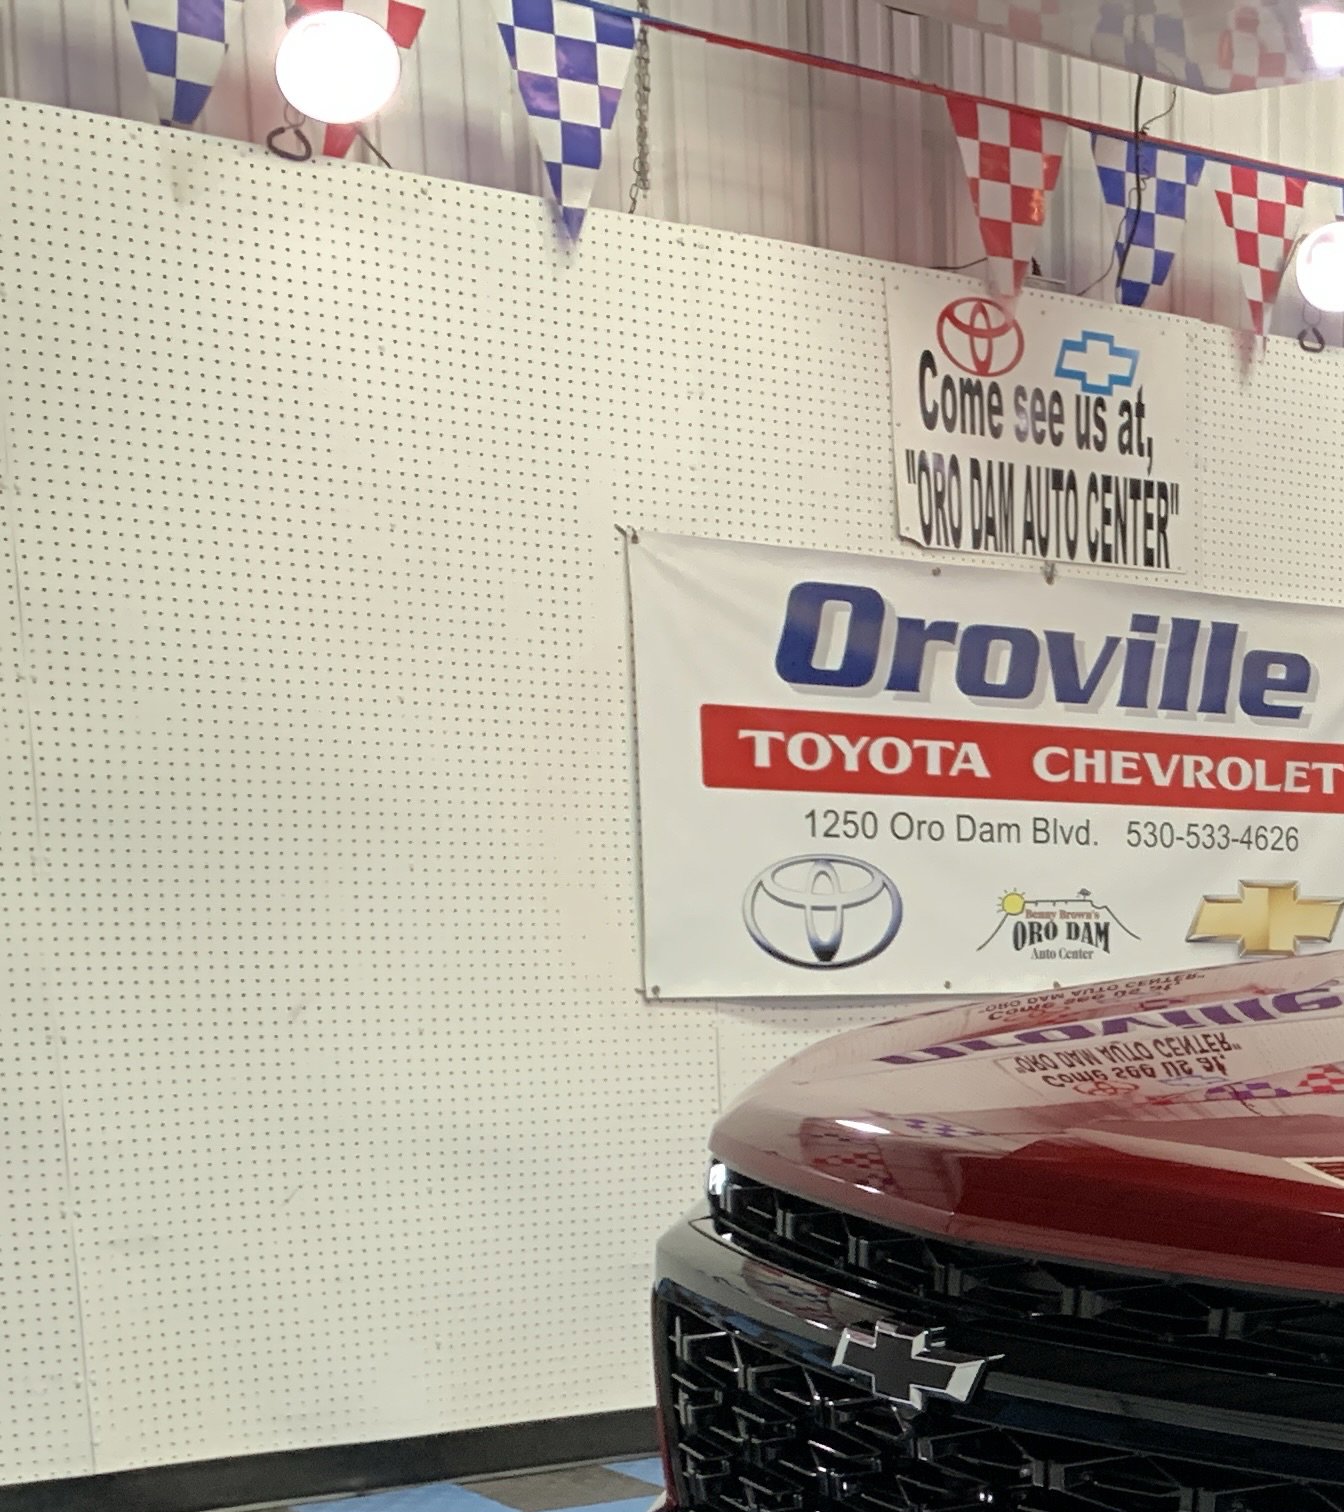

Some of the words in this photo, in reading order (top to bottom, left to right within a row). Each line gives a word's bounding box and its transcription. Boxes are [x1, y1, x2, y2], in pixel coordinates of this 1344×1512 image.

[919, 350, 1004, 439] Come
[1014, 385, 1065, 447] see
[1075, 394, 1108, 452] us
[1118, 385, 1153, 475] at,
[905, 449, 962, 548] "ORO
[970, 458, 1015, 554] DAM
[1023, 465, 1078, 560] AUTO
[1086, 472, 1180, 569] CENTER"
[774, 581, 1313, 721] Oroville
[737, 729, 991, 779] TOYOTA
[804, 809, 879, 841] 1250
[889, 814, 945, 844] Oro
[956, 814, 1021, 845] Dam
[1033, 817, 1100, 847] Blvd.
[1126, 820, 1300, 852] 530-533-4626
[1012, 920, 1058, 951] ORO
[1065, 921, 1111, 954] DAM
[1031, 948, 1057, 959] Auto
[1058, 948, 1095, 959] Center
